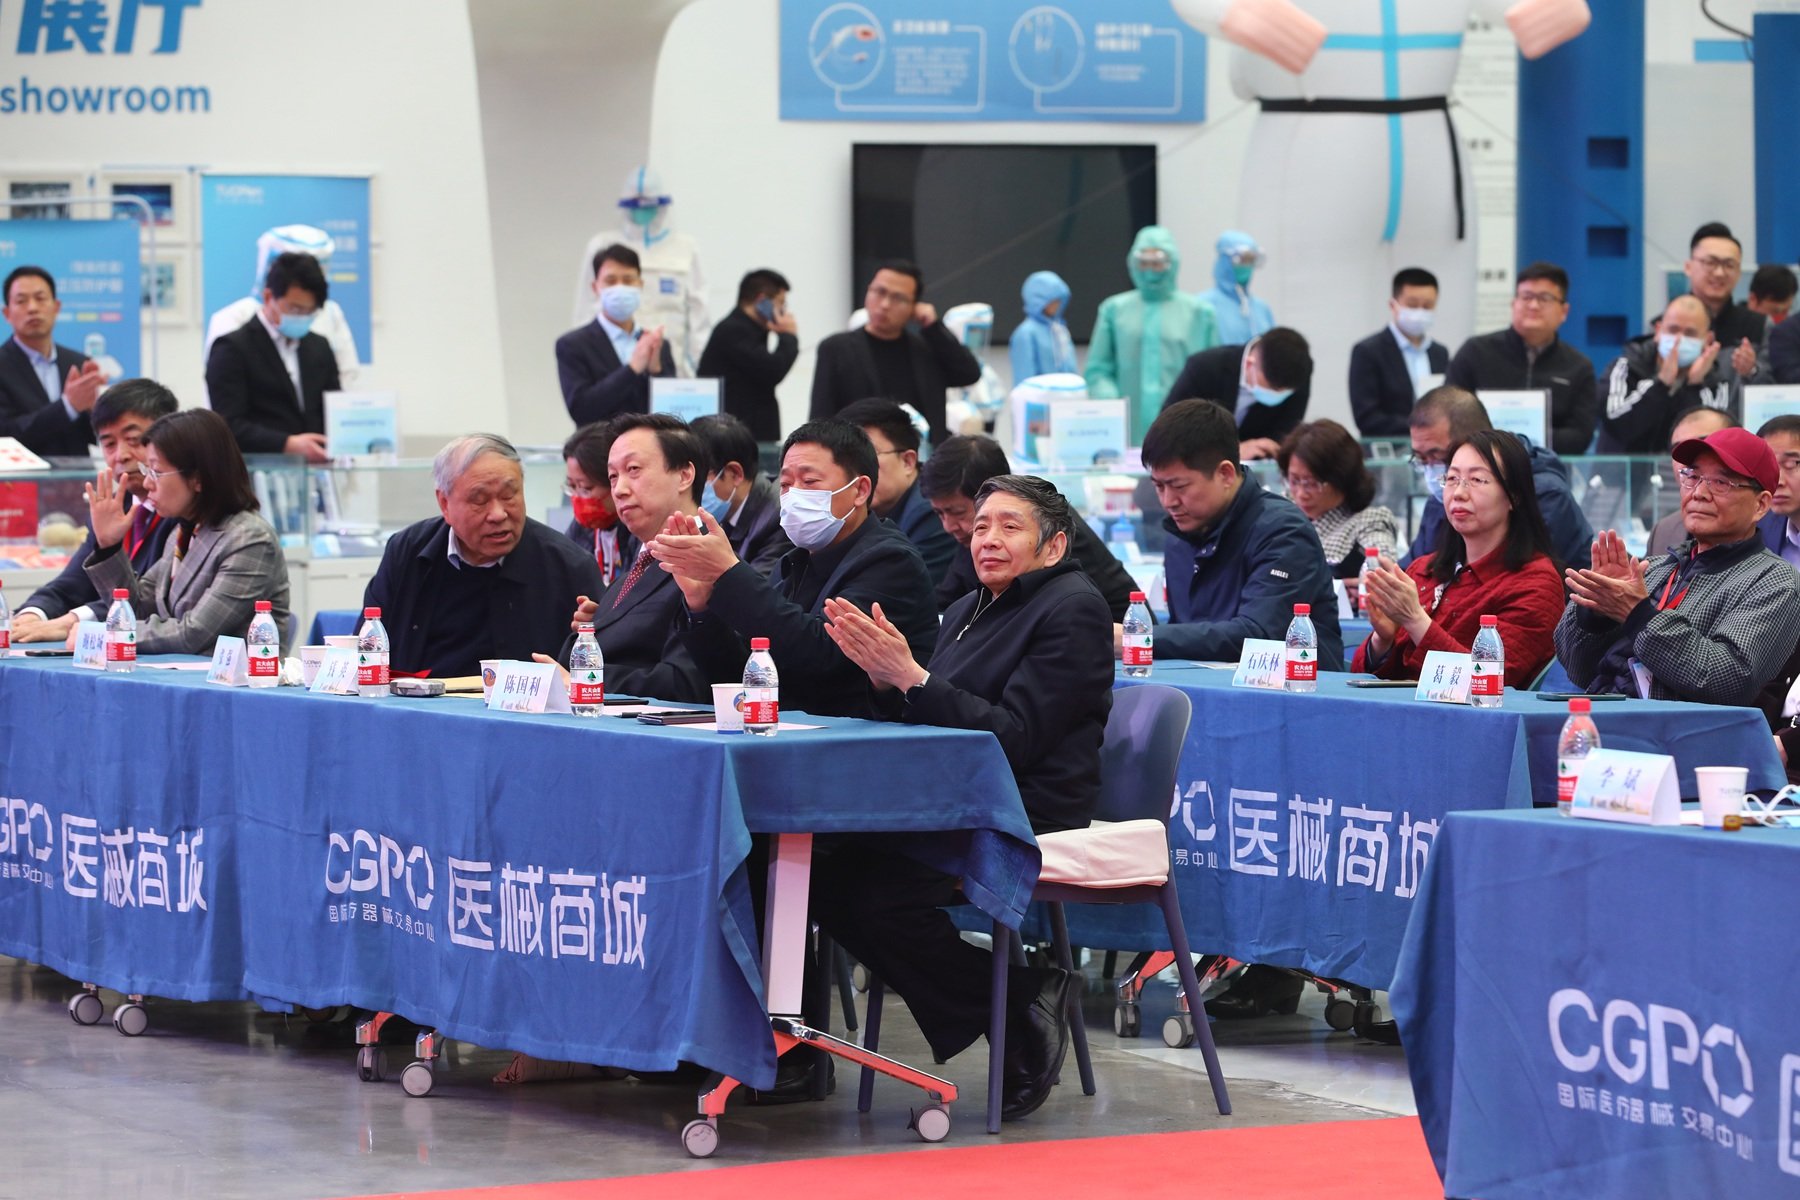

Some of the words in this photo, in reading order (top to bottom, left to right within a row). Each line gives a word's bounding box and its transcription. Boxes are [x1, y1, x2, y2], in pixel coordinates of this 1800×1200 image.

[0, 77, 211, 113] showroom
[503, 674, 541, 697] 陈国利
[325, 829, 434, 911] CGPO
[1170, 848, 1219, 869] 易中心
[447, 855, 647, 970] 医械商城
[1548, 988, 1754, 1118] CGPO
[1557, 1081, 1754, 1162] 国际医疗器械交易中心
